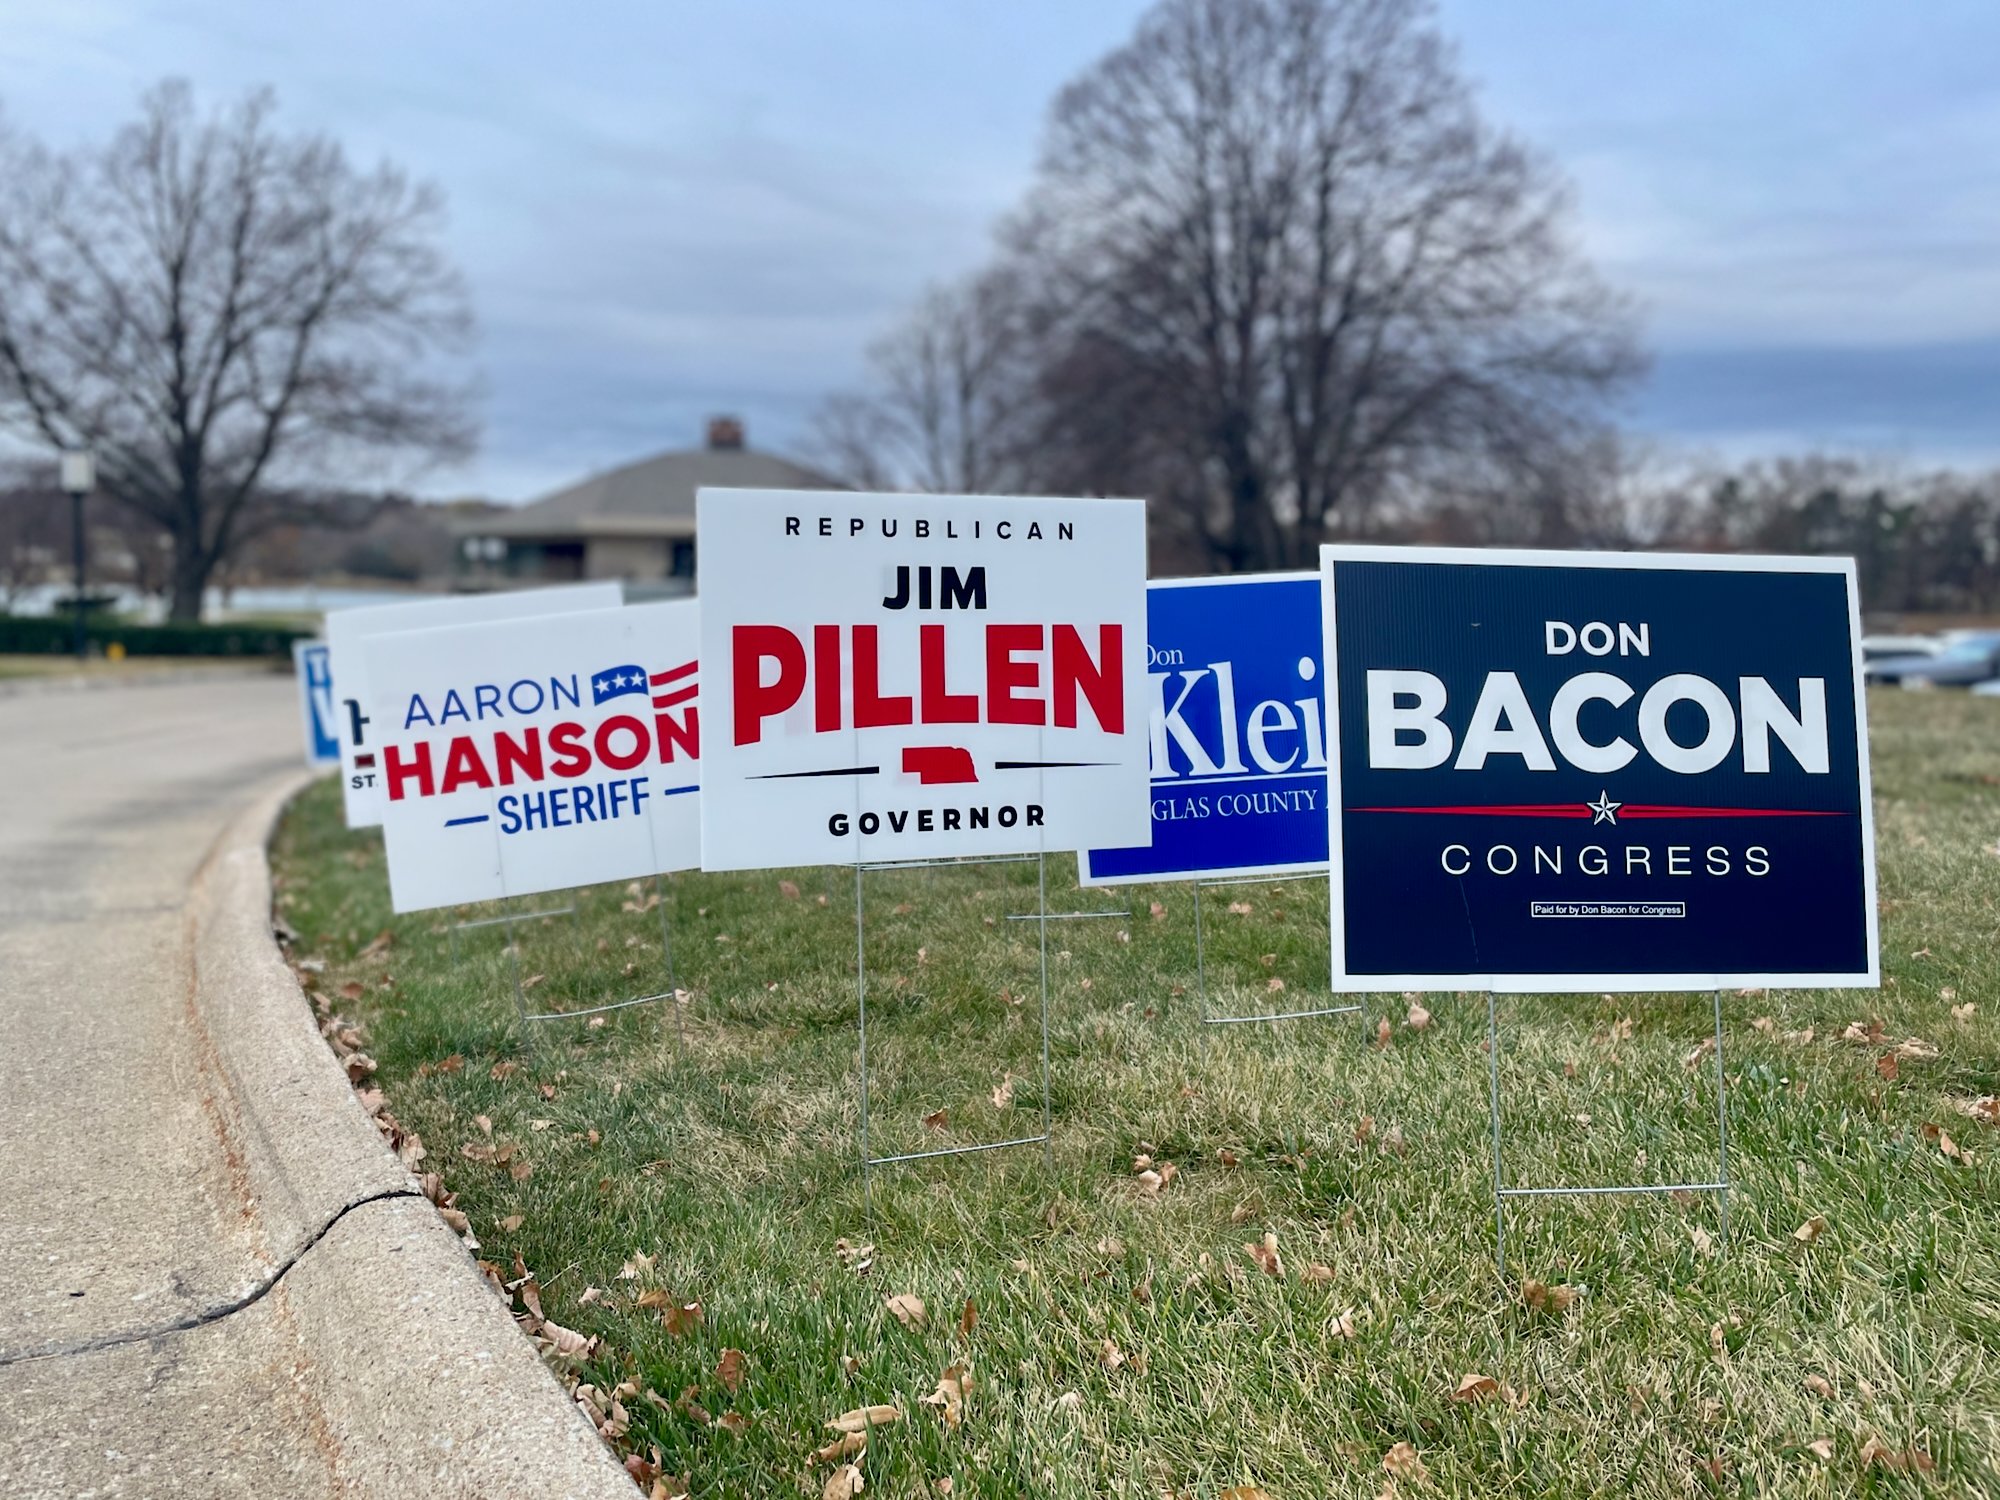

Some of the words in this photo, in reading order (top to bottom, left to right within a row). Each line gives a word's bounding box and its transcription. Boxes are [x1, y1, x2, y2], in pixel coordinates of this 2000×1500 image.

[785, 516, 1075, 541] REPUBLICAN
[882, 565, 988, 611] JIM
[1545, 620, 1651, 657] DON
[404, 674, 582, 729] AARON
[732, 624, 1125, 747] PILLEN
[1148, 656, 1328, 778] Klei
[1366, 669, 1831, 775] BACON
[383, 706, 700, 801] HANSON
[351, 774, 379, 790] ST
[498, 777, 650, 835] SHERIFF
[828, 804, 1046, 837] GOVERNOR
[1151, 796, 1211, 821] GLAS
[1217, 789, 1318, 817] COUNTY
[1440, 844, 1772, 877] CONGRESS
[1534, 905, 1554, 914] Paid
[1555, 905, 1567, 914] for
[1568, 905, 1579, 916] by
[1581, 905, 1599, 914] Don
[1600, 905, 1627, 914] Bacon
[1628, 905, 1640, 914] for
[1641, 905, 1681, 916] Congress
